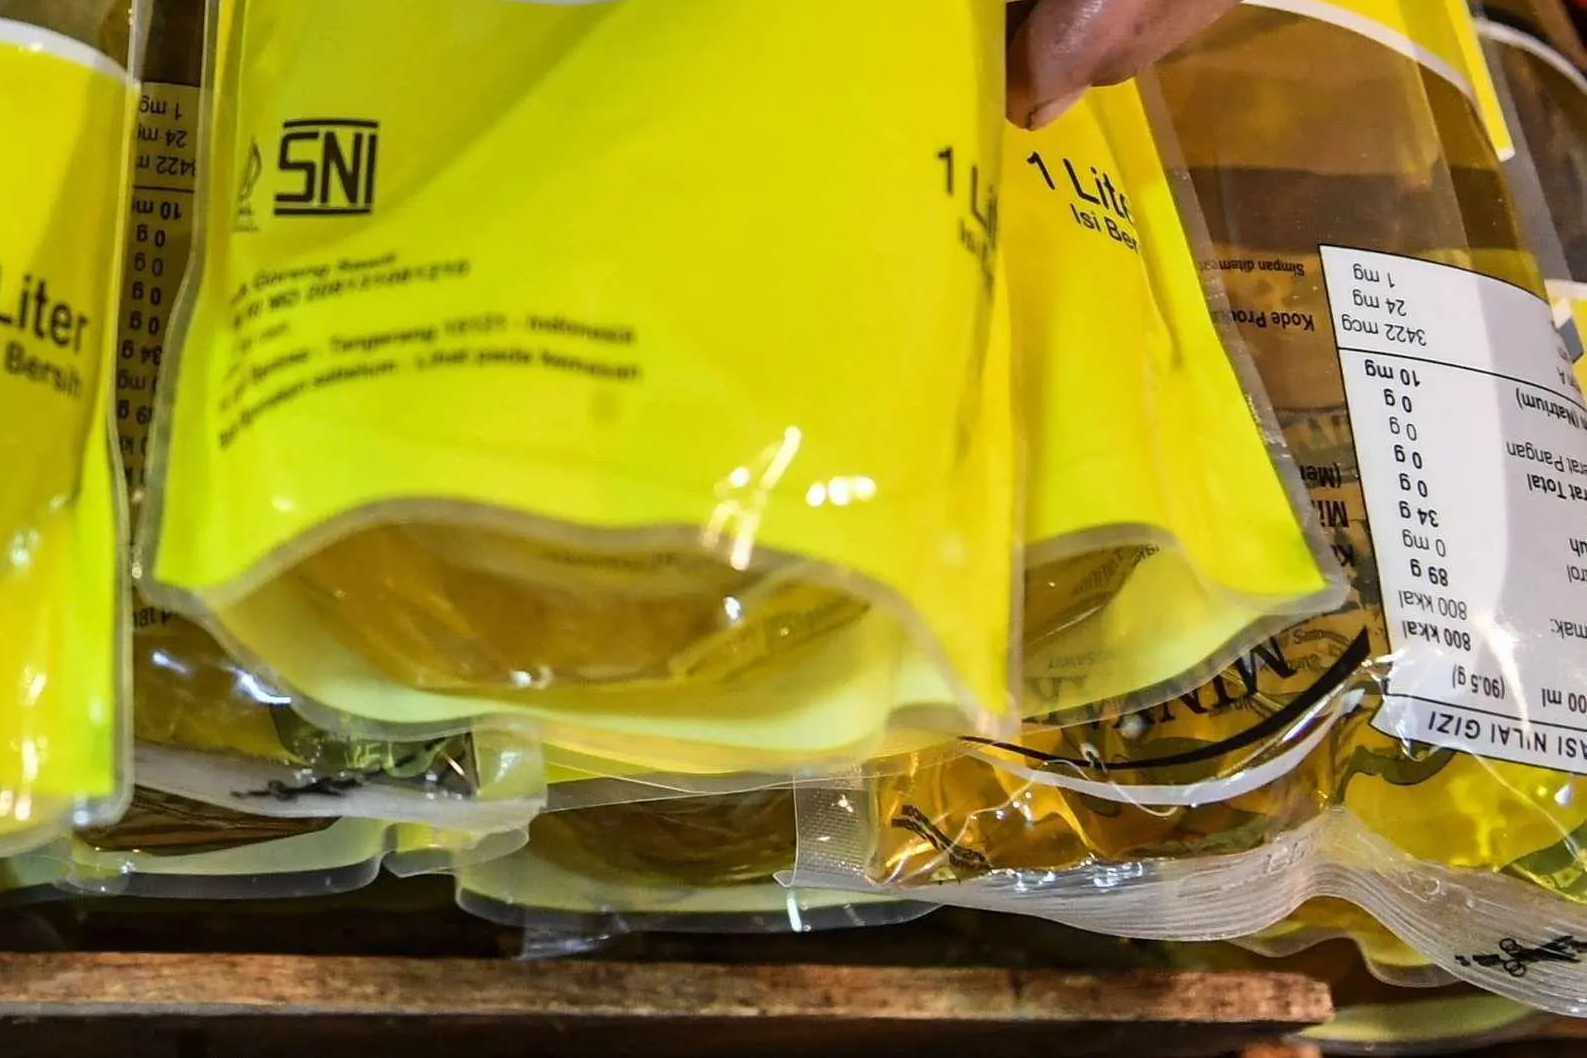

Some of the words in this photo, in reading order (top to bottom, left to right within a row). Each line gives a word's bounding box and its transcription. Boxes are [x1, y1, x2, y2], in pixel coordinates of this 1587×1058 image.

[174, 102, 183, 120] 1
[166, 129, 187, 148] 24
[275, 131, 379, 205] SNI
[1026, 150, 1055, 190] 1
[160, 202, 182, 221] 10
[1070, 203, 1101, 233] Isi
[154, 229, 166, 247] 0
[152, 257, 163, 277] 0
[1259, 260, 1305, 278] Simpan
[1352, 263, 1380, 282] mg
[1386, 271, 1397, 288] 1
[150, 286, 161, 306] 0
[1352, 289, 1380, 309] mg
[1385, 298, 1408, 317] 24
[148, 316, 159, 335] 0
[1271, 312, 1316, 333] Kode
[1341, 313, 1379, 335] mcg
[1383, 322, 1428, 347] 3422
[1364, 358, 1394, 380] mg
[1399, 367, 1421, 388] 10
[1383, 388, 1396, 407] g
[1401, 395, 1412, 413] 0
[1388, 416, 1401, 435] g
[1405, 423, 1418, 441] 0
[1394, 444, 1406, 462] g
[1412, 451, 1423, 469] 0
[1505, 440, 1564, 473] Pangan
[1399, 472, 1411, 491] g
[1417, 479, 1428, 498] 0
[1526, 473, 1564, 499] Total
[1399, 500, 1411, 519] g
[1417, 508, 1439, 528] 34
[1402, 528, 1430, 551] mg
[1435, 538, 1447, 557] 0
[1410, 558, 1422, 578] g
[1428, 566, 1449, 587] 89
[1398, 590, 1434, 613] kkal
[1438, 598, 1468, 621] 800
[1402, 620, 1440, 644] kkal
[1443, 630, 1472, 652] 800
[1452, 664, 1467, 689] g)
[1471, 672, 1506, 700] (90.5
[1541, 688, 1562, 707] ml
[1427, 710, 1482, 740] GIZI
